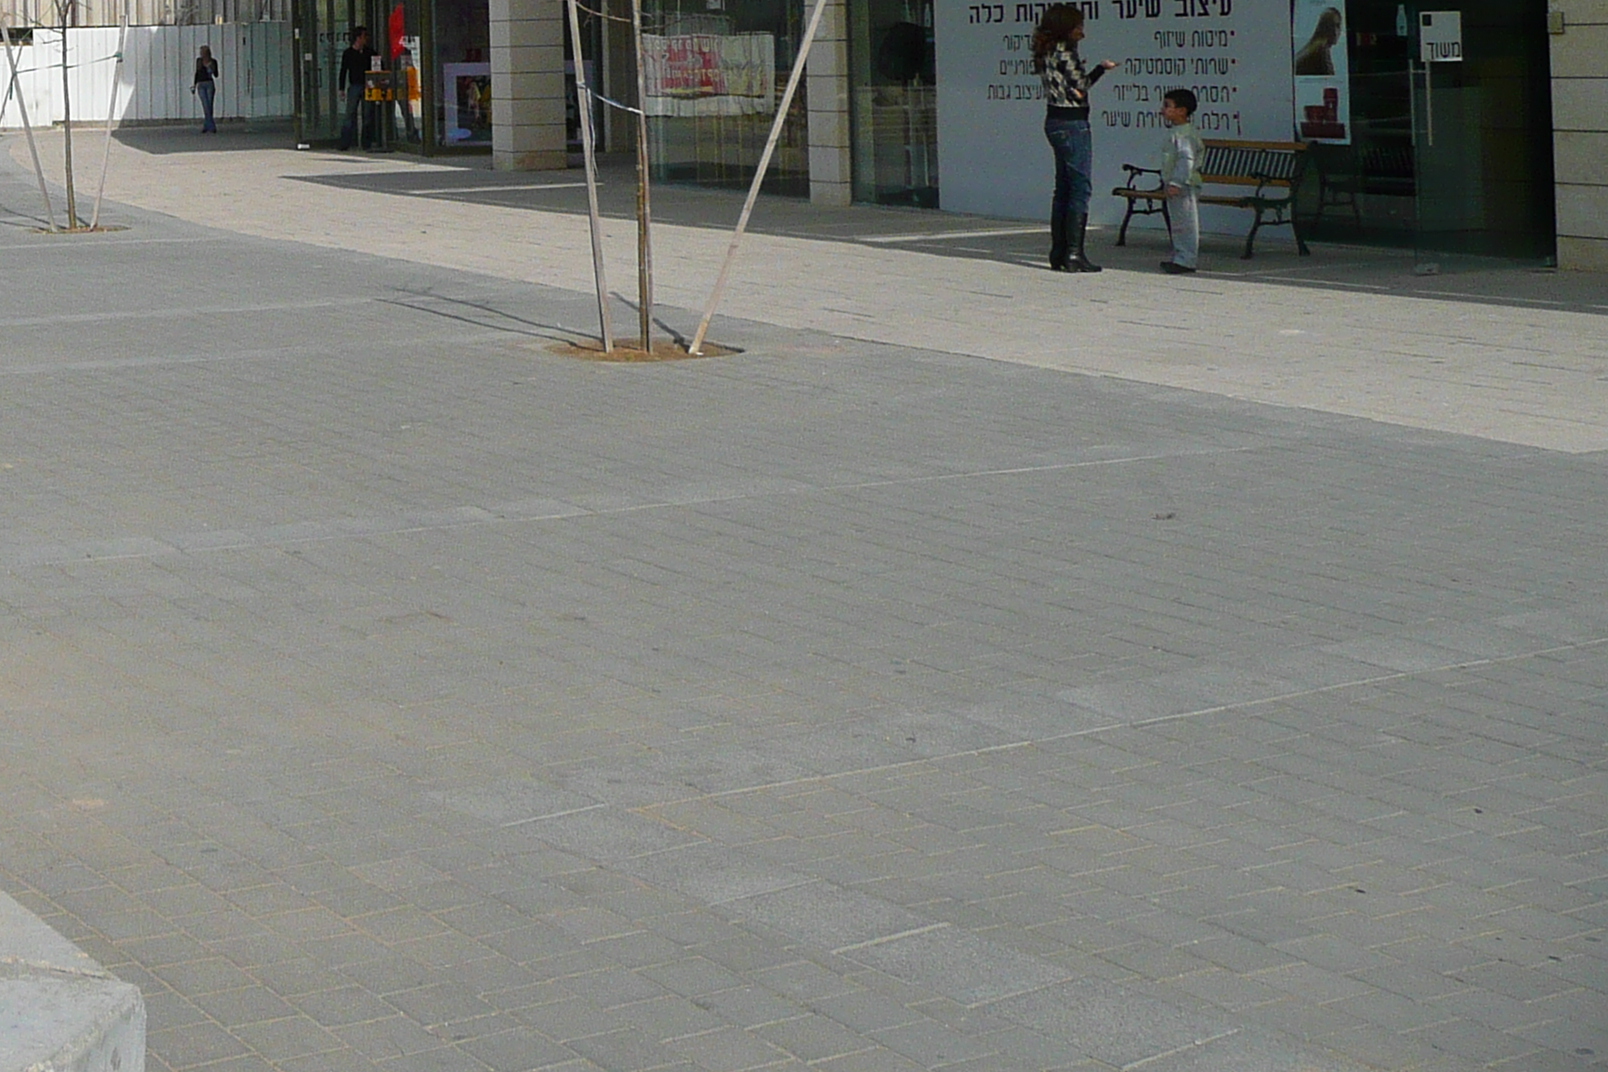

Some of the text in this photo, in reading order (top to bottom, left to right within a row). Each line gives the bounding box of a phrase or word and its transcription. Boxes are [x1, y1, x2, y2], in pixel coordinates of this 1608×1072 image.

[969, 4, 1004, 24] כלה
[1425, 41, 1461, 60] משוך
[1125, 58, 1229, 76] שרותי קוסמטיקה
[1101, 111, 1131, 128] שיער
